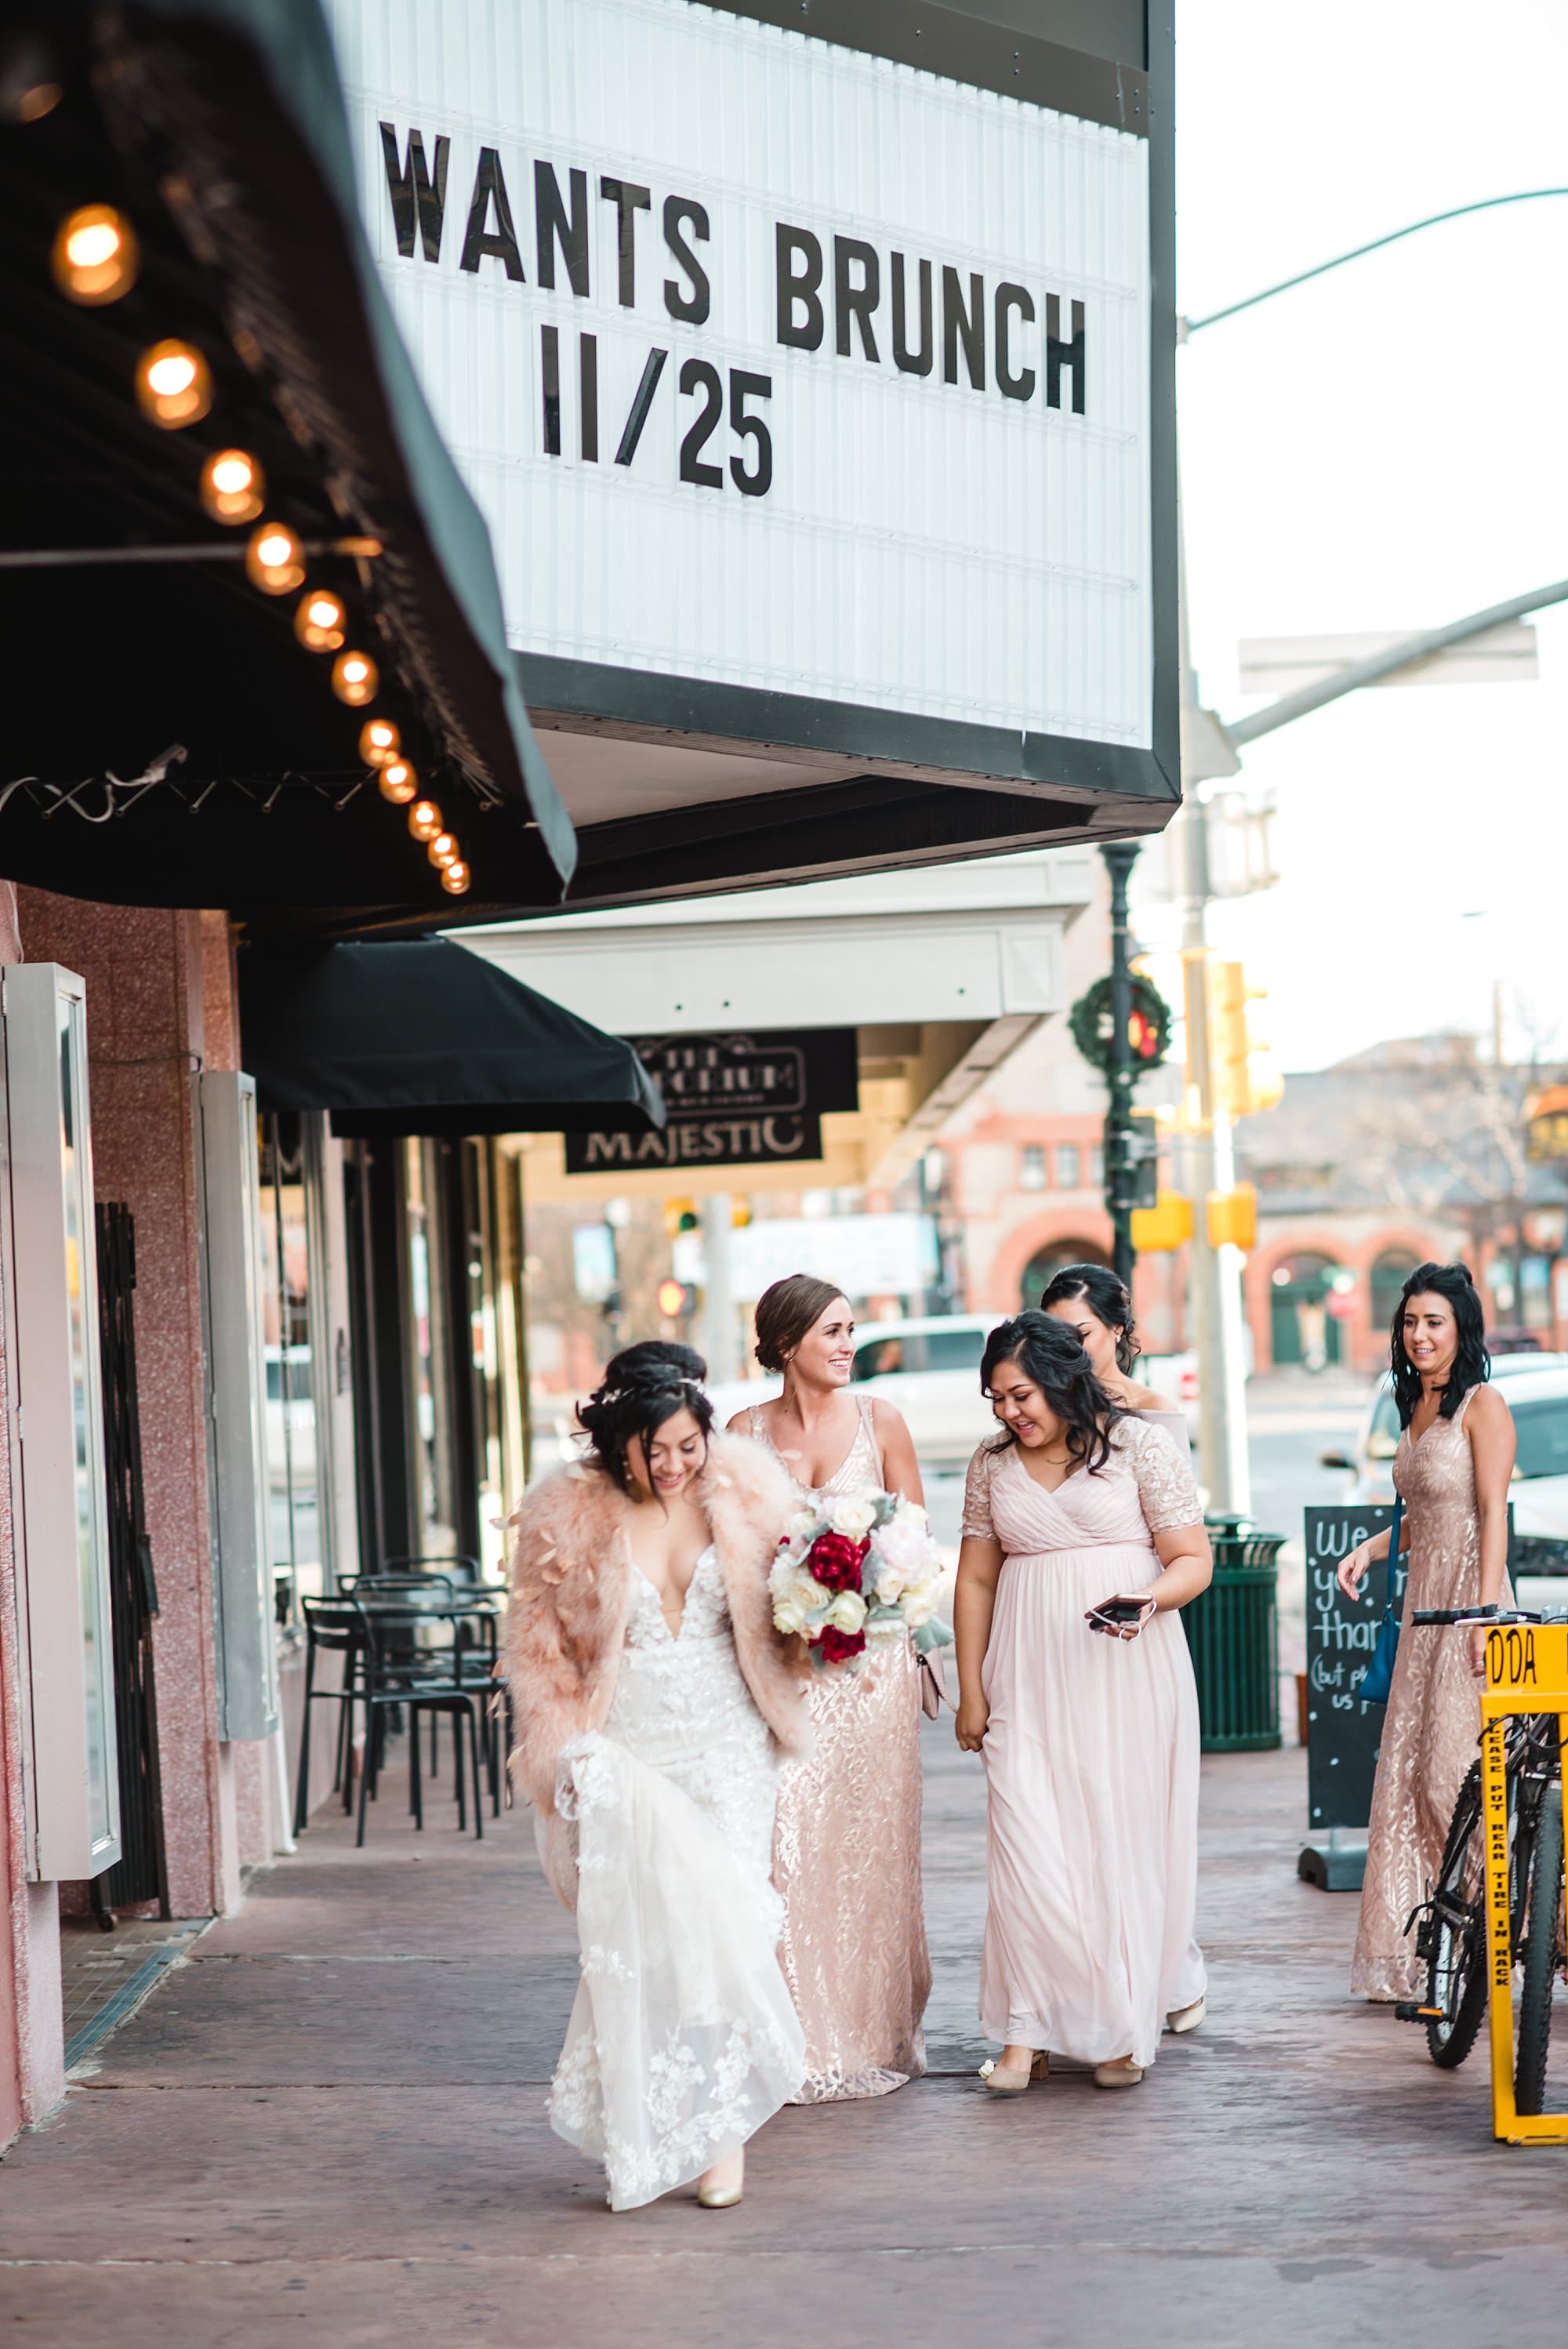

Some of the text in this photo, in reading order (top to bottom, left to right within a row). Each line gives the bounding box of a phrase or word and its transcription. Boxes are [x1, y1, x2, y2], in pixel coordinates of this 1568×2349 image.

[379, 121, 1086, 415] WANTS BRUNCH
[540, 324, 773, 498] 11/25
[585, 1116, 804, 1164] MAJESTIC
[1316, 1521, 1369, 1557] We
[1488, 1629, 1537, 1684] DDA
[1332, 1694, 1354, 1710] us
[1490, 1785, 1504, 1811] PUT
[1491, 1824, 1504, 1860] REAR
[1493, 1872, 1507, 1908] TIRE
[1494, 1920, 1507, 1938] IN
[1495, 1949, 1509, 1987] RACK
